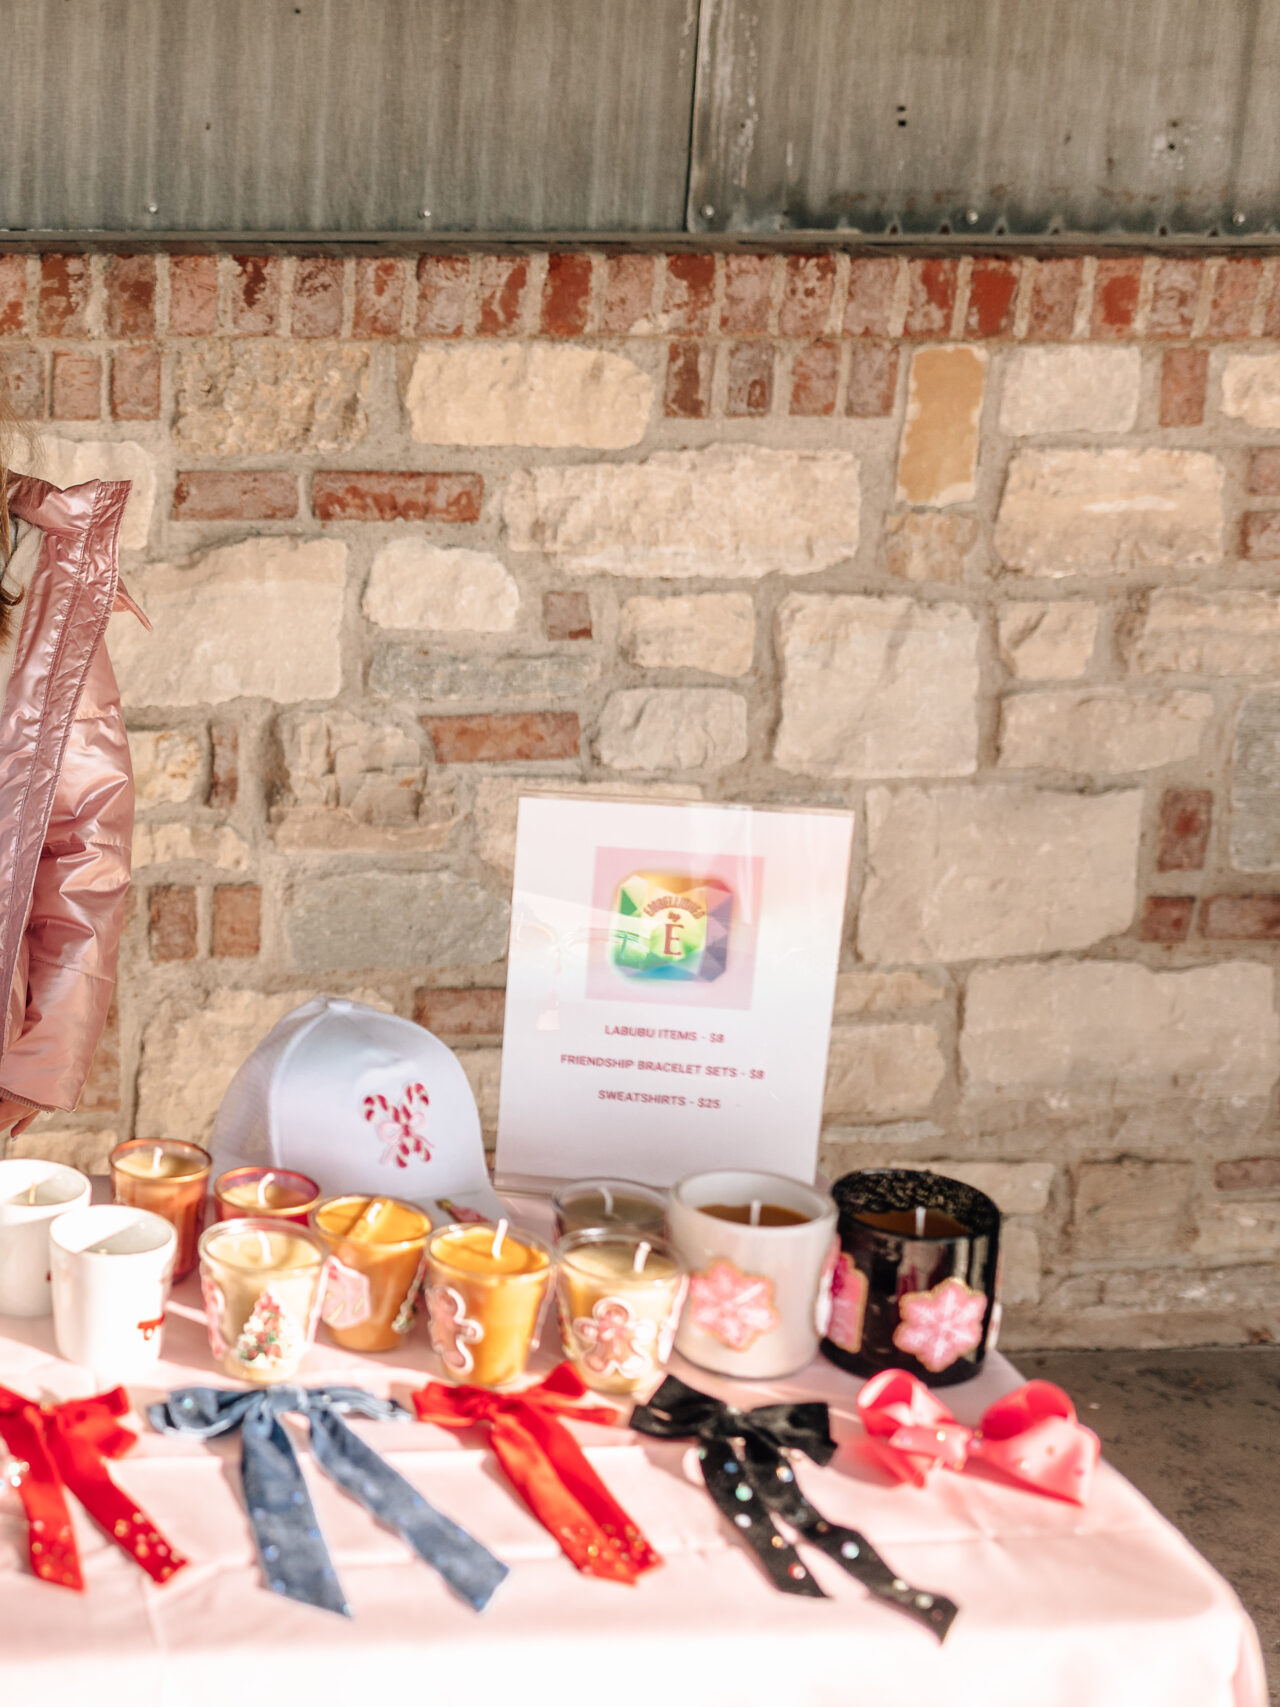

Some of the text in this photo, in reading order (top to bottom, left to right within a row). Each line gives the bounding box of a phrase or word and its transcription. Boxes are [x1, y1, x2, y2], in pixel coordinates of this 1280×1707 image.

[663, 923, 685, 956] E
[604, 1024, 655, 1039] LABUBU
[657, 1029, 698, 1042] ITEMS
[709, 1032, 725, 1044] $8
[560, 1053, 634, 1069] FRIENDSHIP
[637, 1060, 702, 1075] BRACELET
[704, 1065, 738, 1078] SETS
[748, 1068, 766, 1081] $8
[598, 1089, 687, 1107] SWEATSHIRTS
[696, 1096, 722, 1110] $25
